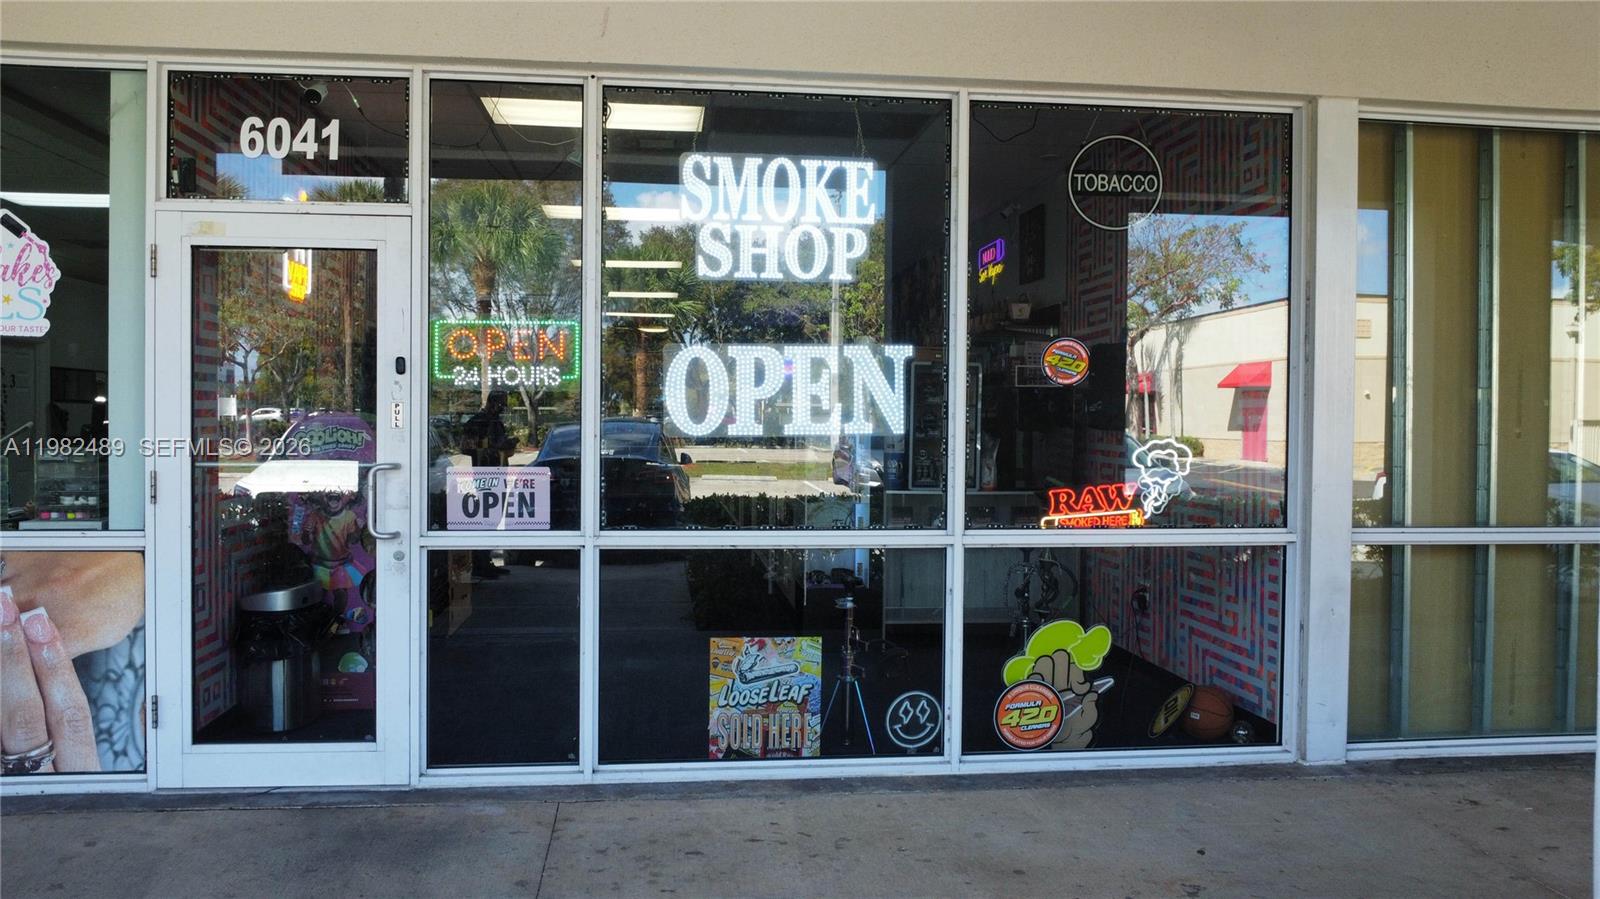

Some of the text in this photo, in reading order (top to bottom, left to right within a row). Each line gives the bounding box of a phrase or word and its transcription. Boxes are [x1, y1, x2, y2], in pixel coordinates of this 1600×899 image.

[239, 116, 341, 161] 6041
[680, 153, 876, 225] SMOKE
[1073, 173, 1158, 193] TOBACCO
[697, 221, 868, 281] SHOP
[447, 328, 567, 361] OPEN
[453, 366, 562, 386] 24 HOURS
[1045, 354, 1088, 374] 420
[664, 344, 914, 436] OPEN
[460, 477, 487, 489] ME
[487, 477, 500, 488] IN
[461, 491, 536, 518] OPEN
[1049, 482, 1138, 516] RAW
[1060, 516, 1128, 527] SMOKED HERE
[1001, 705, 1059, 728] 420
[1005, 700, 1043, 711] FORMULA
[718, 712, 812, 750] SOLD HERE
